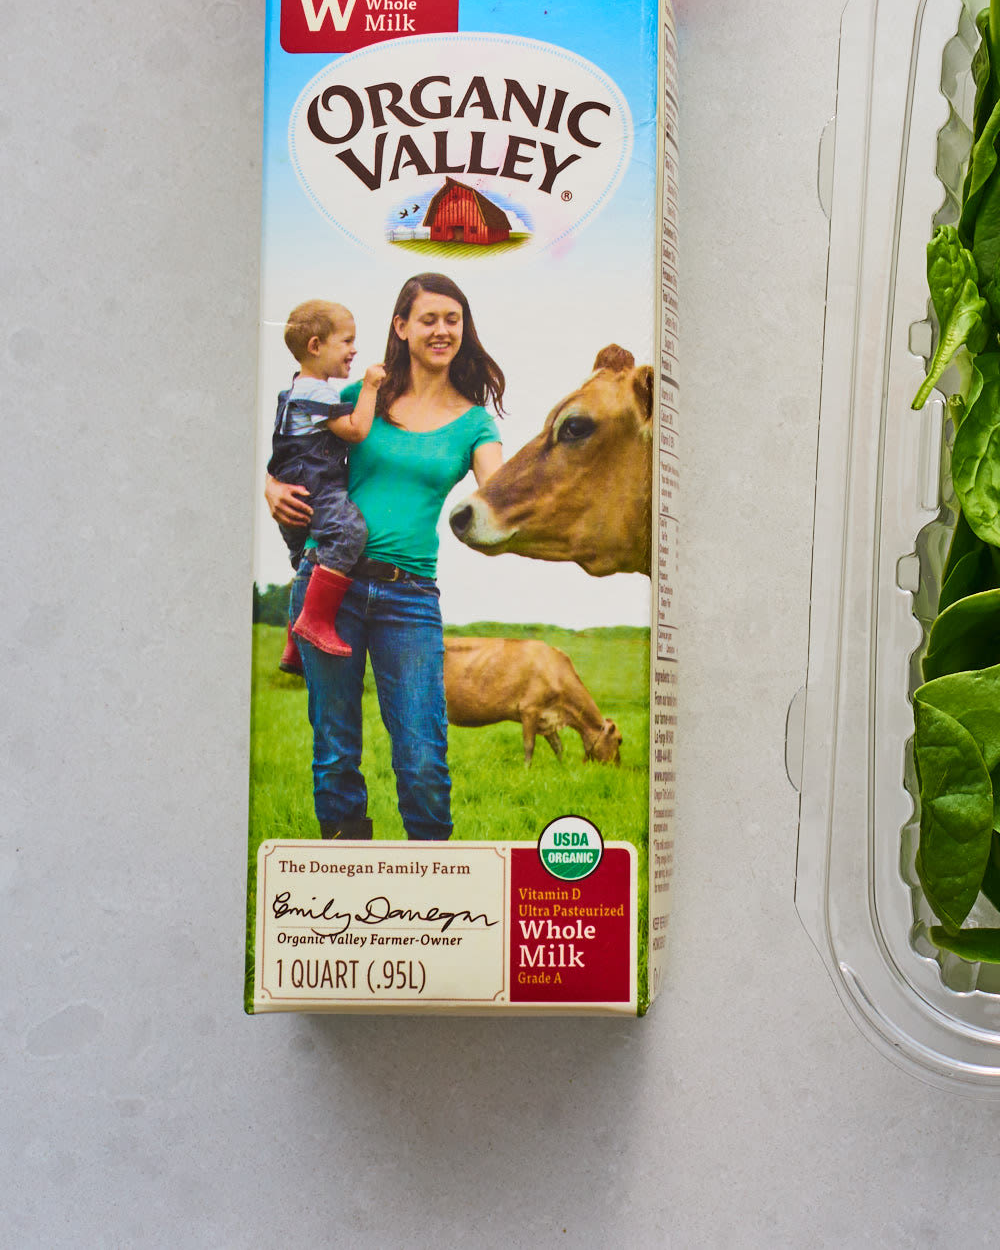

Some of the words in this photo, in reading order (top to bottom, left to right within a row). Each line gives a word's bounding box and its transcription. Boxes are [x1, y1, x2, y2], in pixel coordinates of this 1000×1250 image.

[364, 13, 416, 32] Milk
[306, 75, 611, 149] ORGANIC
[335, 130, 582, 195] VALLEY
[553, 832, 589, 846] USDA
[548, 852, 594, 864] ORGANIC
[279, 860, 306, 874] The
[309, 861, 374, 877] Donegan
[377, 862, 428, 877] Family
[432, 862, 471, 874] Farm
[518, 887, 569, 900] Vitamin
[572, 888, 581, 900] D
[518, 904, 550, 917] Ultra
[553, 904, 624, 917] Pasteurized
[518, 919, 596, 940] Whole
[277, 933, 325, 947] Organic
[329, 934, 367, 948] Valley
[370, 934, 463, 946] Farmer-Owner
[518, 944, 586, 968] Milk
[276, 959, 283, 988] 1
[291, 959, 360, 989] QUART
[367, 960, 426, 994] (.95L)
[517, 972, 551, 984] Grade
[553, 972, 562, 984] A
